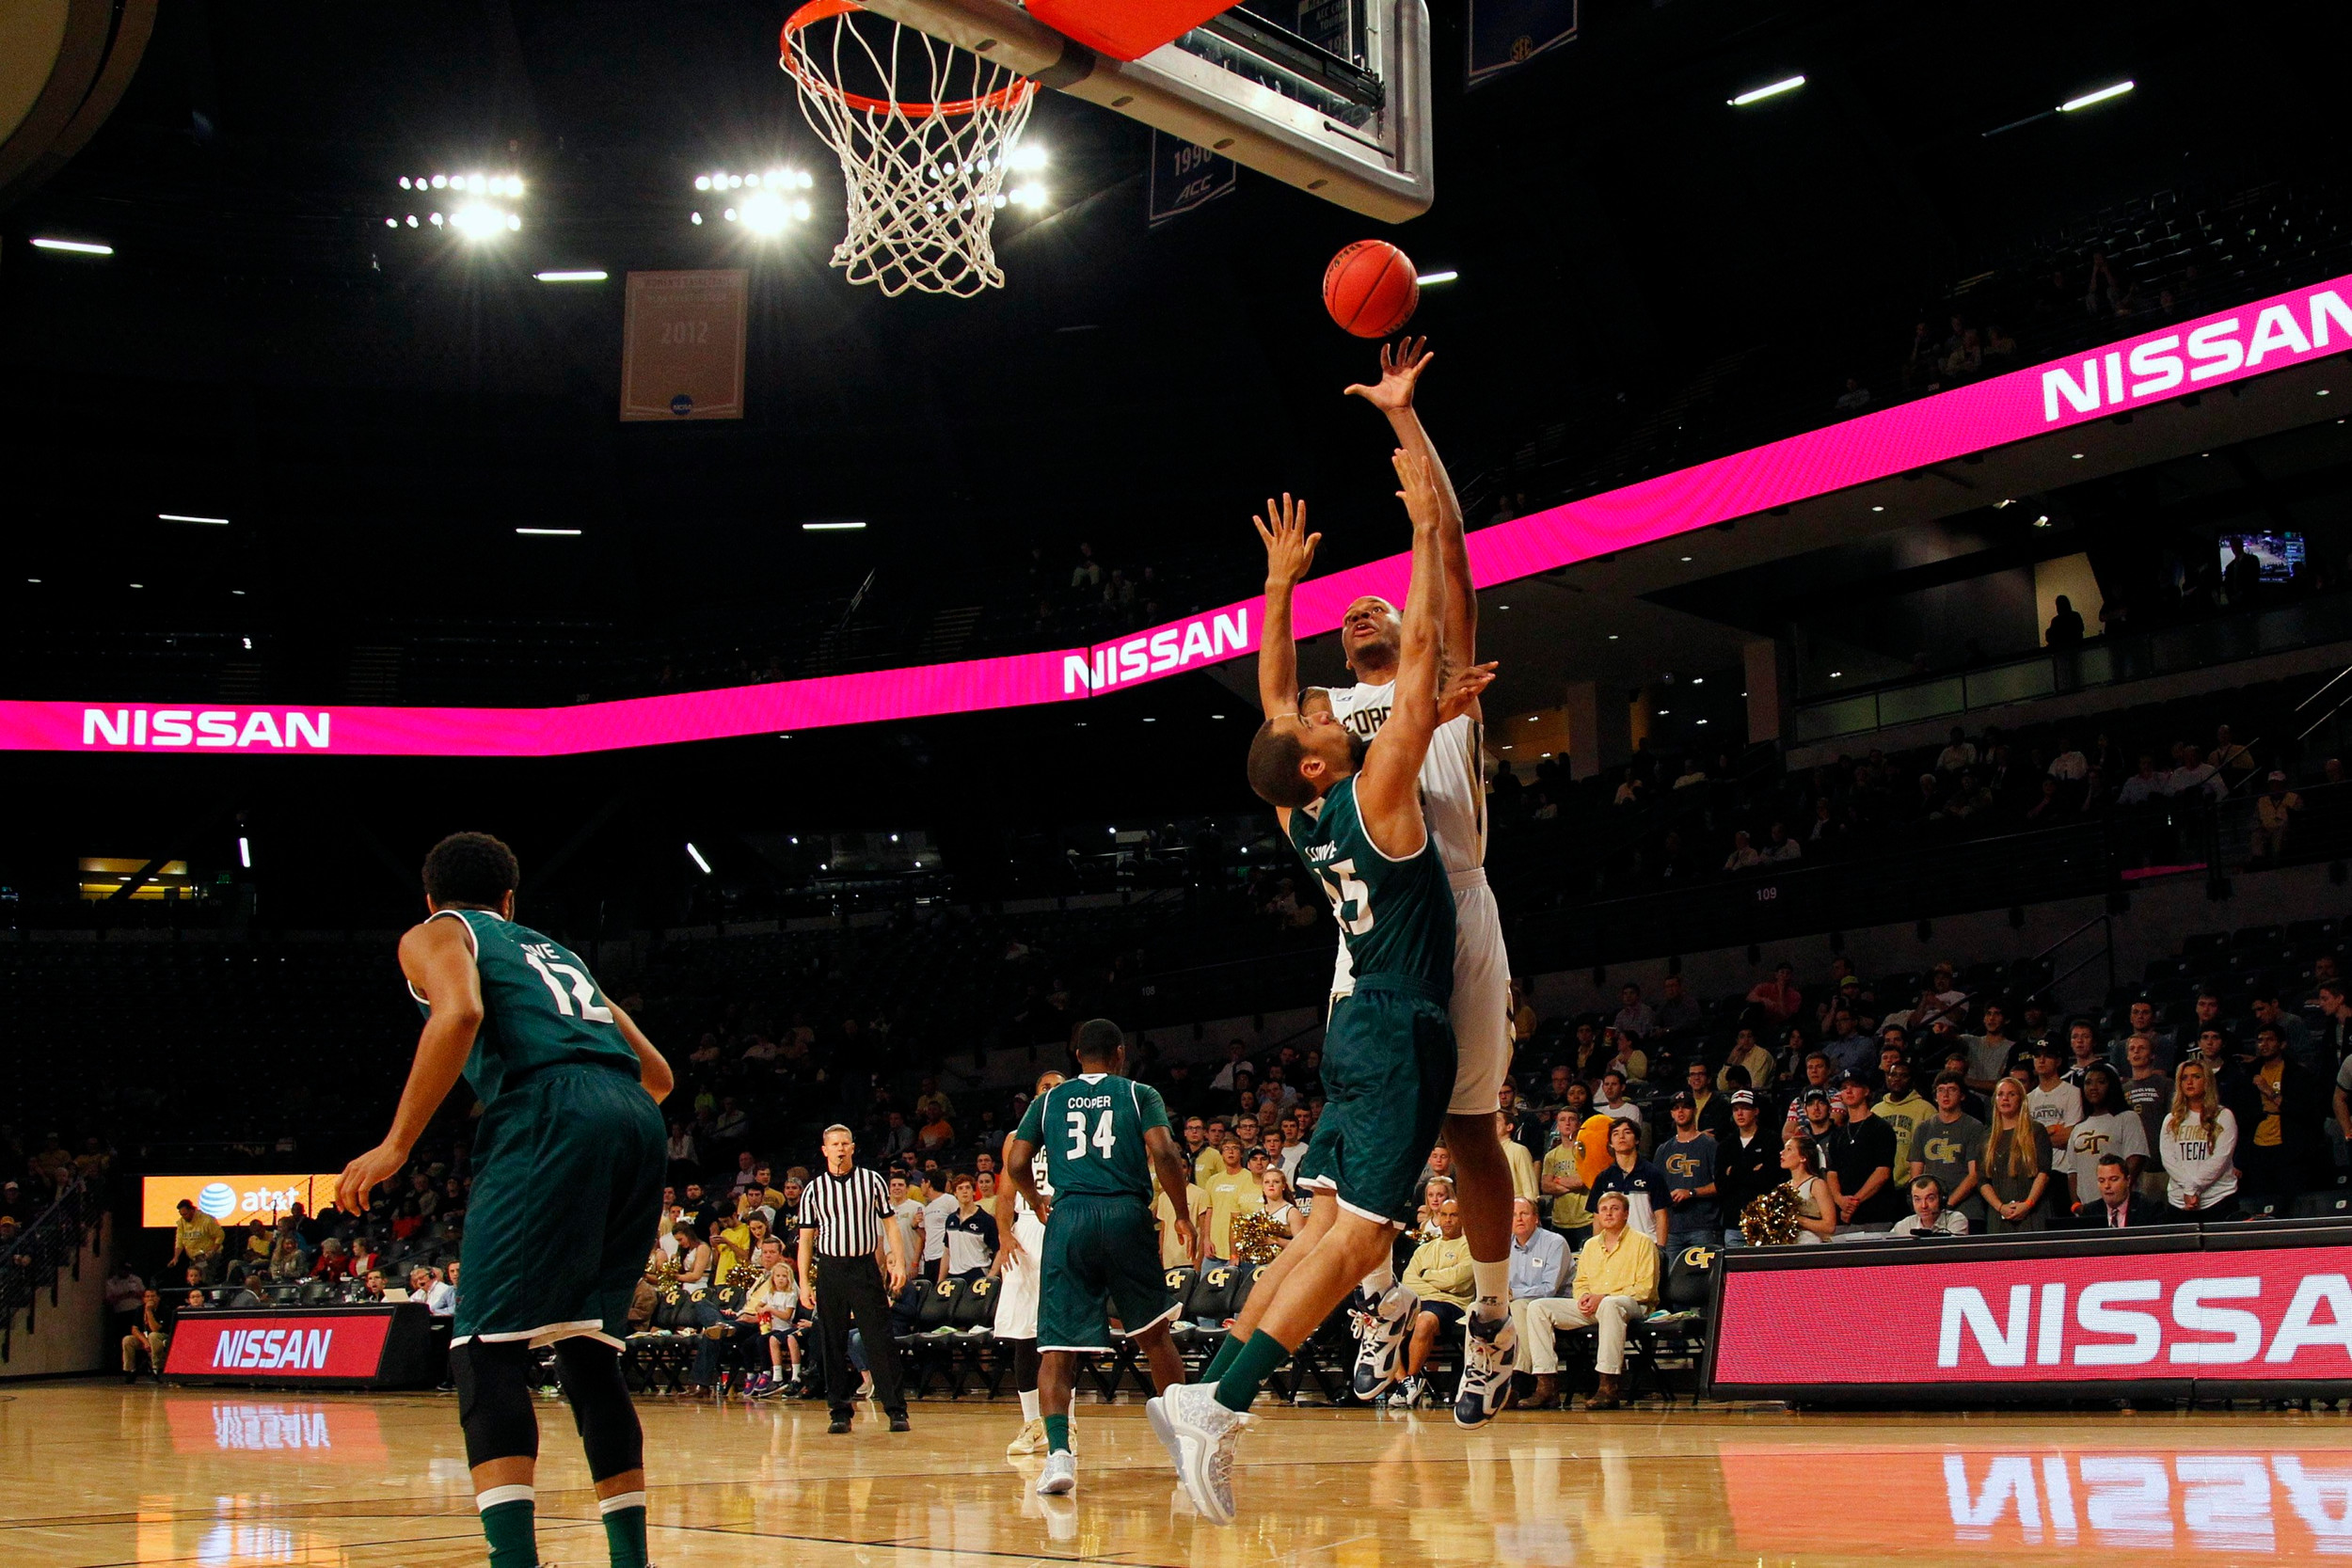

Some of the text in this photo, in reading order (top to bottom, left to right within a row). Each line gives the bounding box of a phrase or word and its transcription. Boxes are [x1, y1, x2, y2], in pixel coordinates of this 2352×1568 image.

[1175, 173, 1214, 204] ACC
[660, 320, 708, 345] 2012
[2042, 290, 2352, 422] NISSAN
[1064, 608, 1248, 694] NISSAN
[83, 708, 330, 749] NISSAN
[1756, 886, 1777, 902] 109
[524, 952, 614, 1024] 12
[1067, 1095, 1112, 1110] COOPER
[1066, 1110, 1117, 1161] 34
[2179, 1141, 2207, 1161] TECH
[1665, 1153, 1701, 1178] GT
[241, 1186, 300, 1212] at&t
[1684, 1246, 1715, 1270] GT
[1937, 1274, 2352, 1368] NISSA
[212, 1328, 333, 1370] NISSAN
